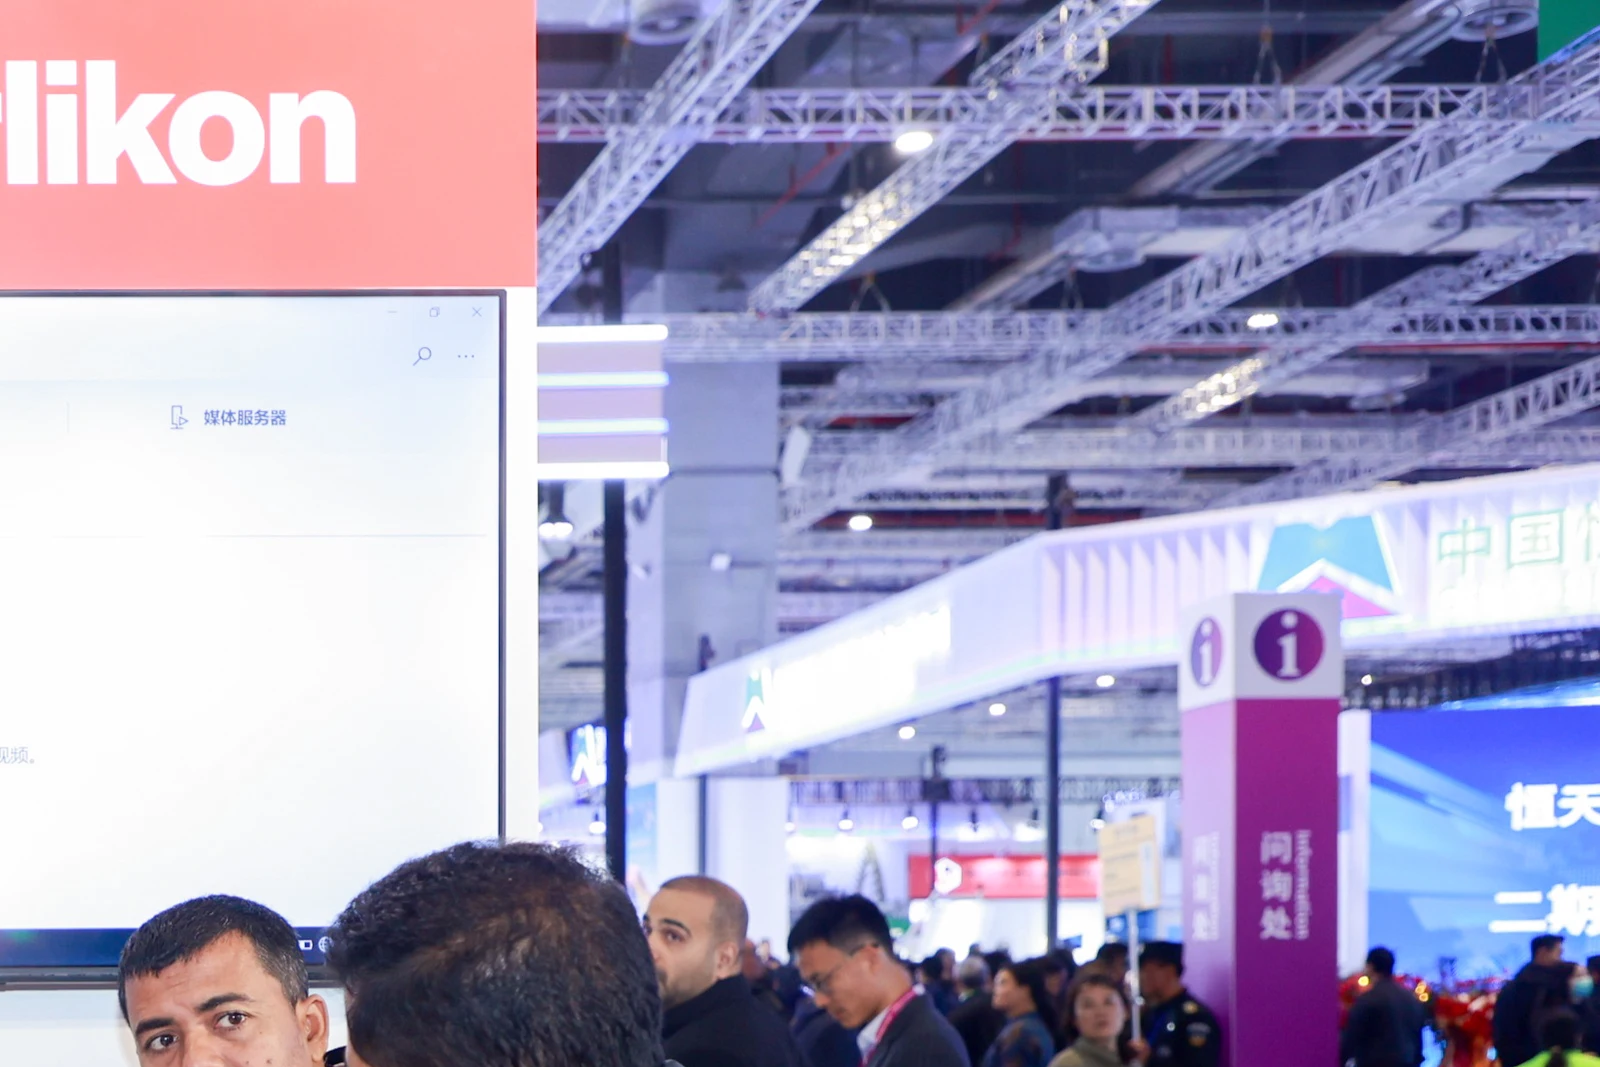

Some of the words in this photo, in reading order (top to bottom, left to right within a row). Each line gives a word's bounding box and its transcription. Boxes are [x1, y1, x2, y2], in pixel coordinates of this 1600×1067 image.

[203, 409, 288, 427] 媒体服务器
[1437, 501, 1600, 575] 中国
[1260, 831, 1293, 940] 问询处
